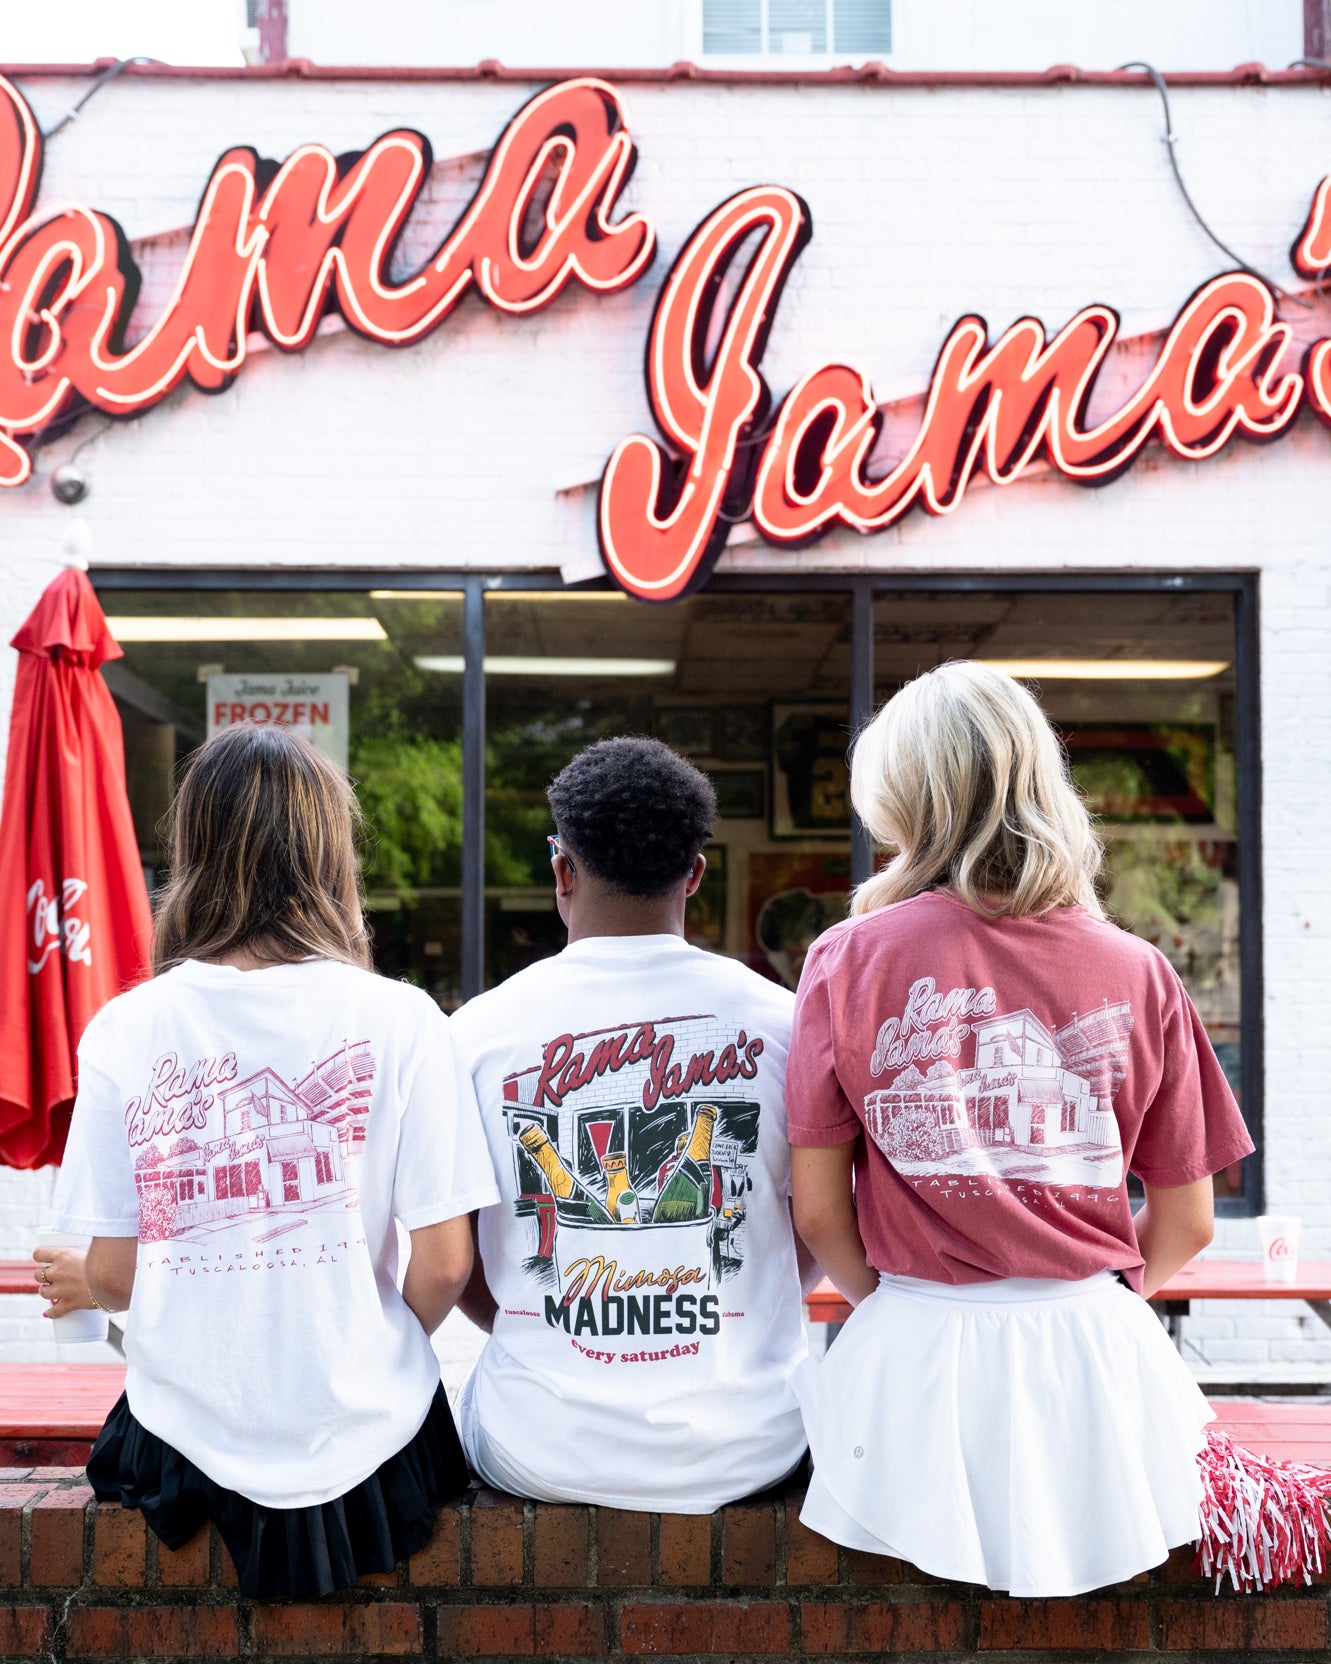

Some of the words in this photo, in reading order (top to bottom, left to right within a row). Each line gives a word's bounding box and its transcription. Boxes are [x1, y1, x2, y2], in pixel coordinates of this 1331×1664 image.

[0, 76, 657, 487] ama
[598, 175, 1331, 601] Jama'
[234, 679, 276, 697] Jama
[280, 680, 320, 697] Juice
[214, 702, 330, 726] FROZEN
[900, 976, 997, 1038] Rama
[534, 1022, 656, 1107] Rama
[643, 1030, 764, 1113] Jama's
[870, 1017, 970, 1077] Jama's
[143, 1051, 238, 1115] Rama
[123, 1090, 215, 1148] Jama's
[316, 1255, 338, 1265] AL
[319, 1237, 367, 1252] 199
[563, 1255, 707, 1306] Mimosa
[504, 1309, 541, 1317] tuscaloosa
[544, 1294, 721, 1337] MADNESS
[571, 1338, 616, 1364] every
[620, 1340, 701, 1363] saturday
